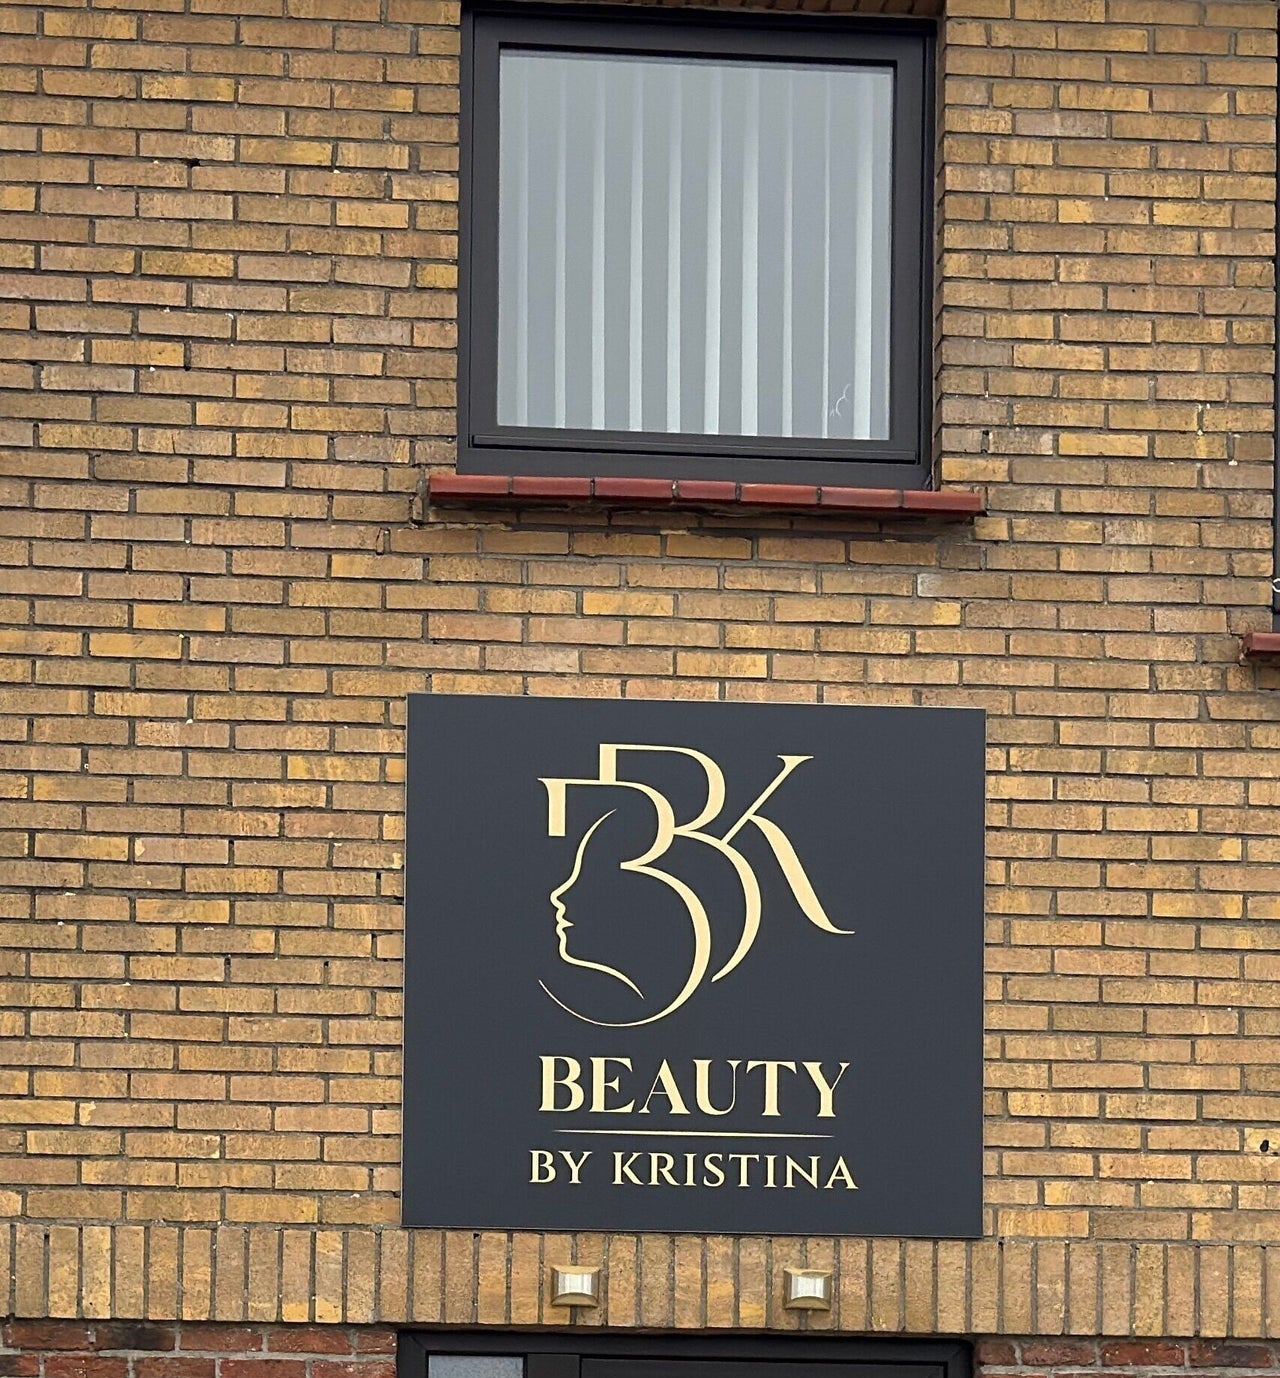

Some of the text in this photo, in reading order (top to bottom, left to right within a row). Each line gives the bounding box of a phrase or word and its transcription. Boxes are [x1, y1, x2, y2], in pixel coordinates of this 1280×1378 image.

[539, 1056, 850, 1117] BEAUTY
[530, 1150, 858, 1189] BY KRISTINA
